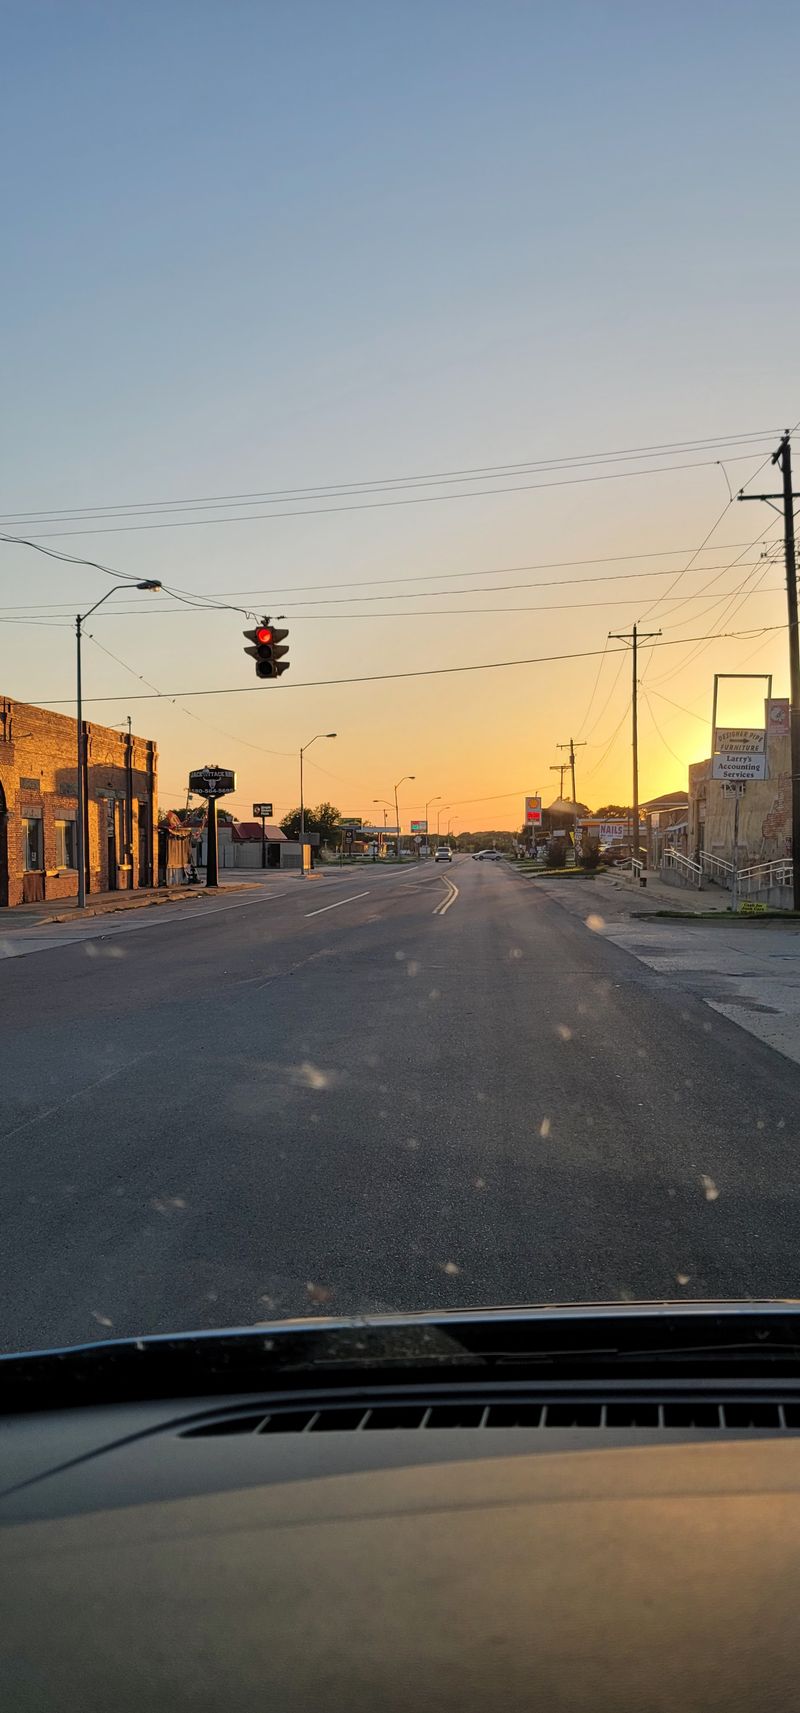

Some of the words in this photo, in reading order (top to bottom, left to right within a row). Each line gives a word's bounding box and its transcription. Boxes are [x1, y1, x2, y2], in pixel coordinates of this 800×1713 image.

[718, 731, 747, 742] DESIGNER
[750, 732, 763, 743] PIPE
[718, 763, 761, 772] Accounting
[600, 825, 623, 834] NAILS
